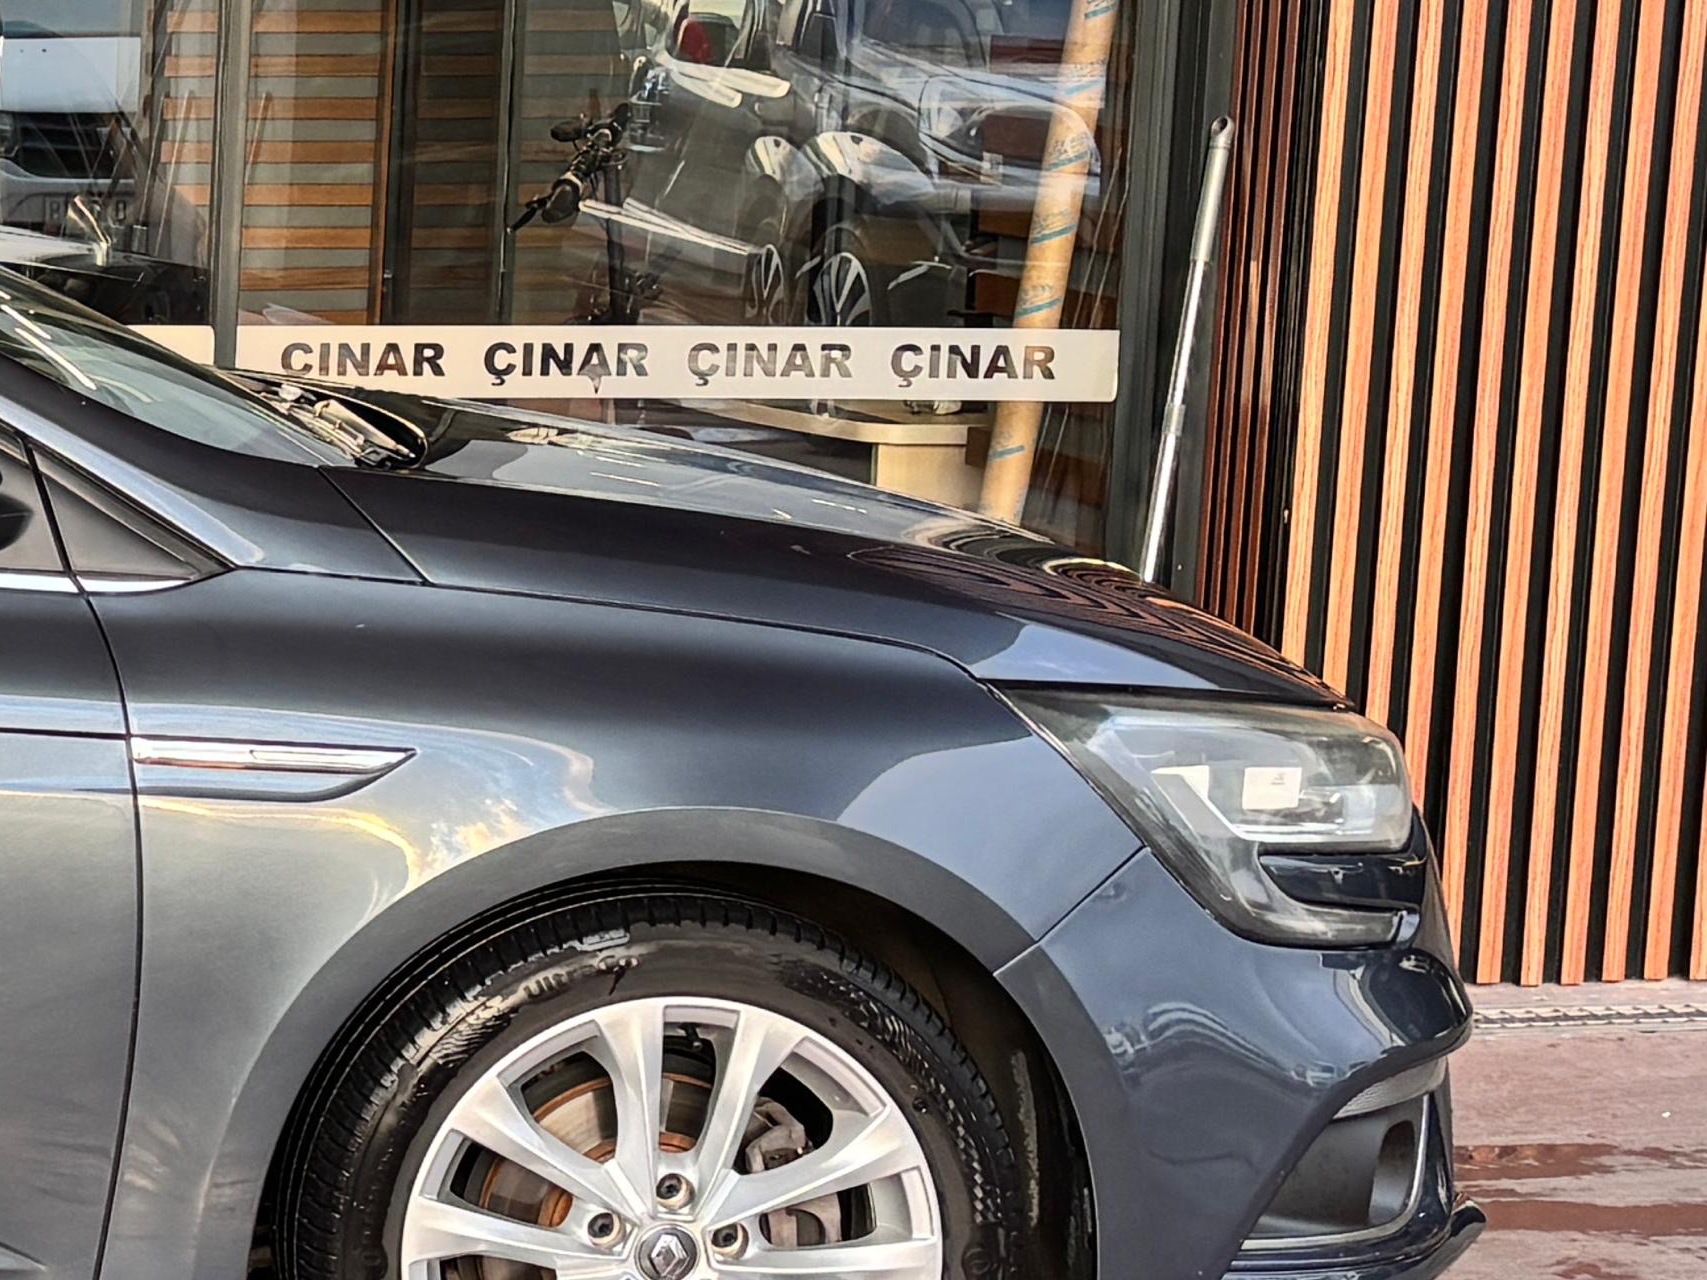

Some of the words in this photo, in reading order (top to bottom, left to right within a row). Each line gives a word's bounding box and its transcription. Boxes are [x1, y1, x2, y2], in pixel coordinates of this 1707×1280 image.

[483, 342, 649, 387] ÇINAR
[687, 343, 853, 387] ÇINAR
[891, 344, 1056, 388] ÇINAR
